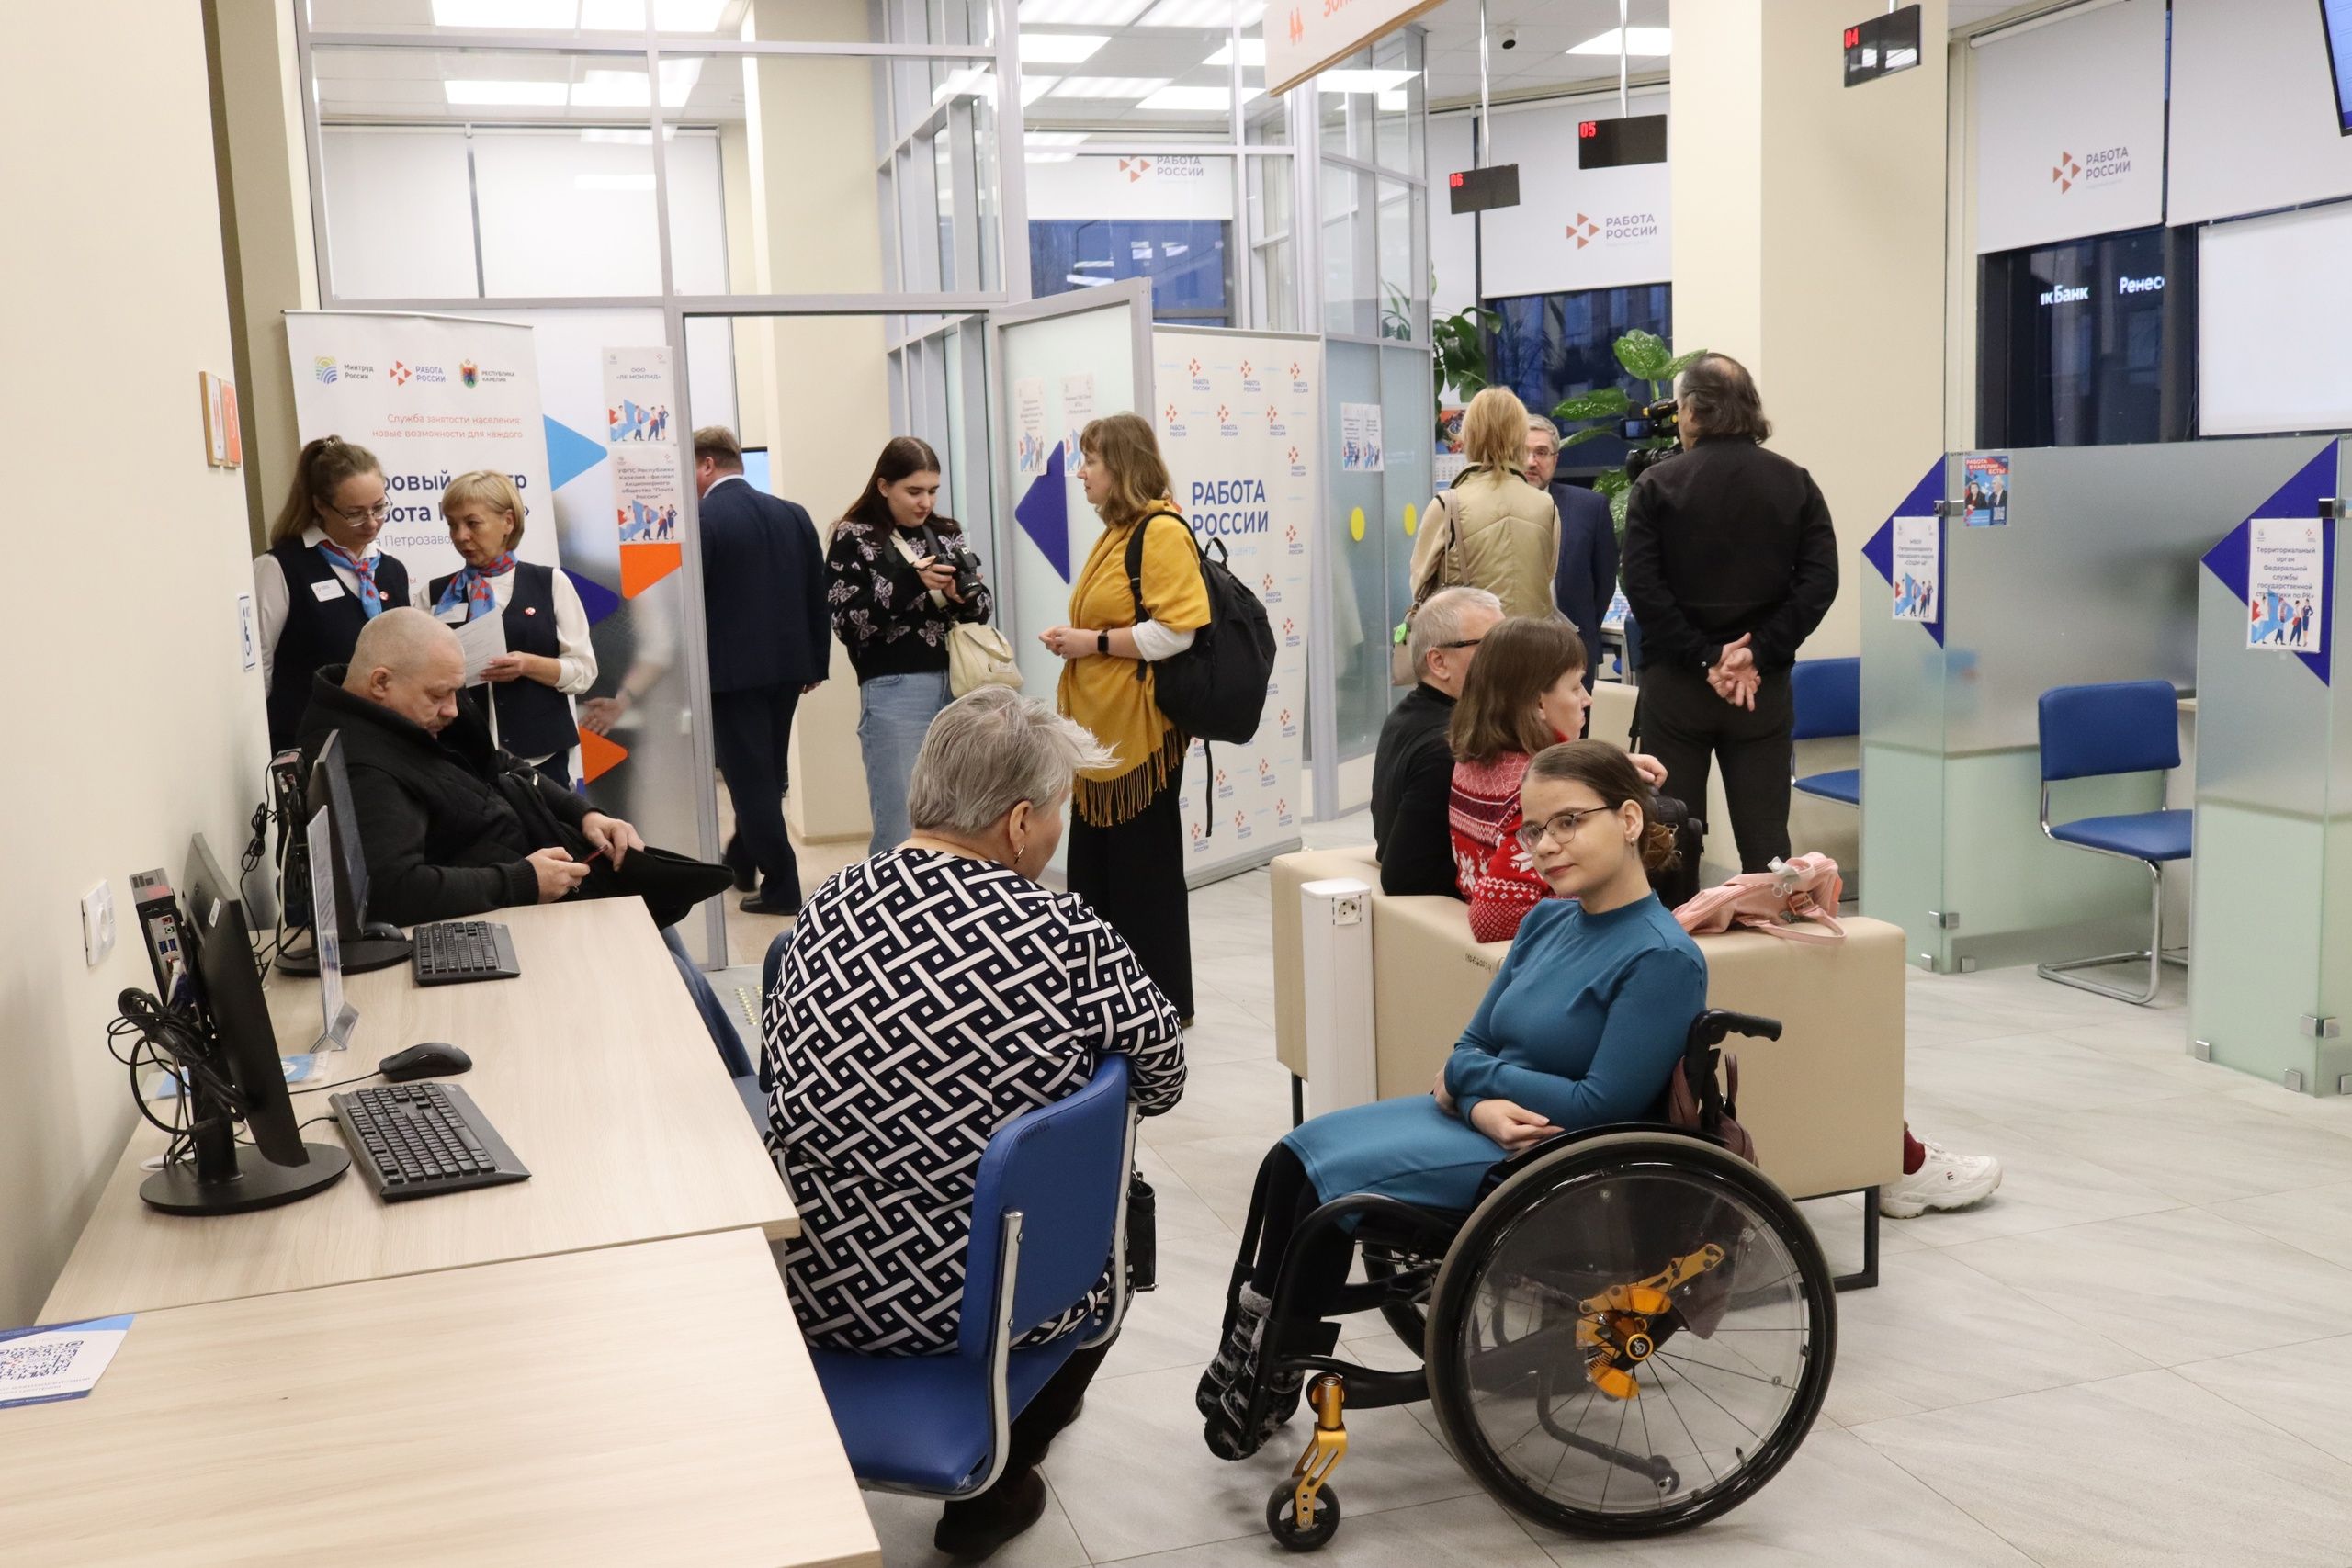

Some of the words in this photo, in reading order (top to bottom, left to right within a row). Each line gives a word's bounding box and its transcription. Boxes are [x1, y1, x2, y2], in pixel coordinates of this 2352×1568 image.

[1845, 27, 1859, 49] 04
[1579, 122, 1596, 138] 05
[1157, 155, 1202, 165] РАБОТА
[2086, 147, 2129, 165] РАБОТА
[1157, 167, 1204, 176] РОССИИ
[2086, 161, 2131, 180] РОССИИ
[1450, 173, 1464, 187] 06
[1605, 214, 1655, 227] РАБОТА
[1606, 226, 1657, 240] РОССИИ
[344, 364, 374, 373] Минтруд
[415, 366, 443, 375] РАБОТА
[416, 374, 447, 383] РОССИИ
[387, 413, 424, 424] Служба
[426, 416, 470, 424] занятости
[472, 416, 522, 424] населения:
[372, 430, 402, 438] новые
[404, 430, 465, 438] возможности
[468, 431, 485, 439] для
[486, 431, 523, 439] каждого
[1192, 479, 1266, 506] РАБОТА
[1193, 511, 1269, 536] РОССИИ
[384, 535, 453, 548] Петрозаво
